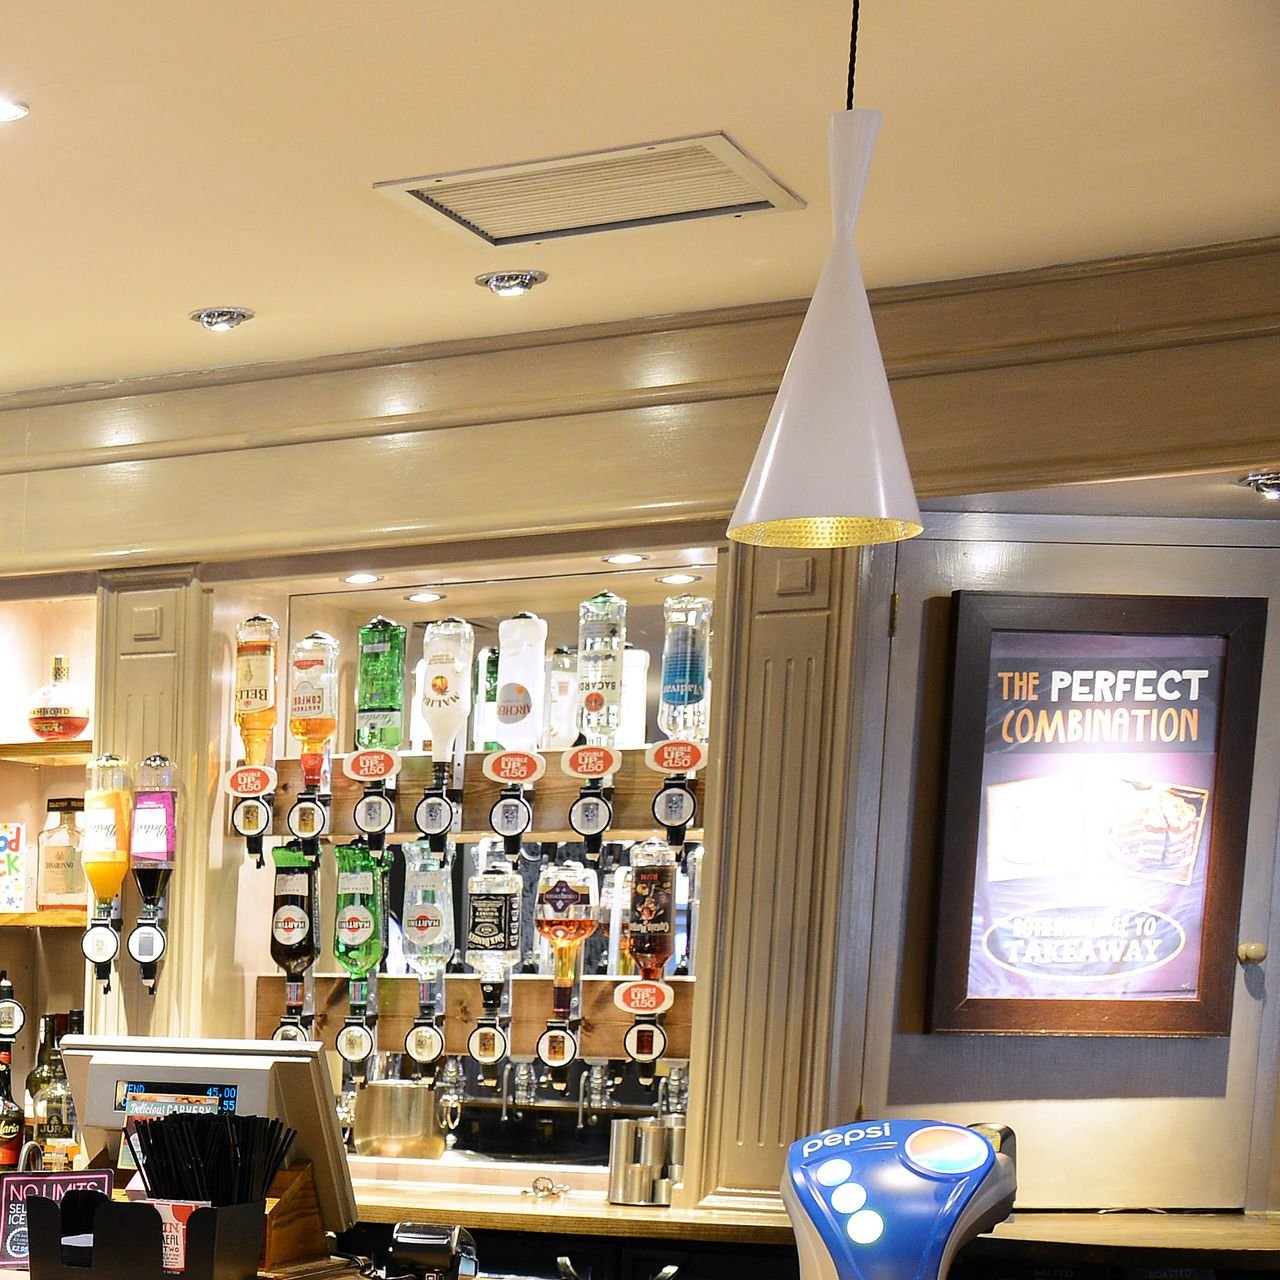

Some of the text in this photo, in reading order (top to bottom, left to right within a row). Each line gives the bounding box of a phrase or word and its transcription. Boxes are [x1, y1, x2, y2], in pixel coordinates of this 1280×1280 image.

[579, 681, 616, 691] BACARD
[998, 669, 1209, 702] THE PERFECT
[422, 691, 461, 708] MALIB
[31, 707, 70, 715] AMBORD
[1001, 707, 1199, 743] COMBINATION
[578, 756, 597, 765] UP
[663, 751, 683, 760] UP
[359, 759, 377, 768] UP
[501, 762, 521, 770] UP
[237, 776, 254, 784] UP
[1003, 939, 1163, 963] TAKEAWAY
[630, 992, 649, 1000] UP
[206, 1087, 236, 1099] 45.00
[129, 1102, 166, 1116] Delicious
[218, 1100, 236, 1112] .55
[40, 1124, 69, 1133] JURA
[803, 1123, 891, 1158] pepsi
[9, 1183, 39, 1201] NO
[8, 1203, 28, 1214] SEL
[8, 1214, 26, 1225] ICE
[163, 1222, 180, 1233] IN
